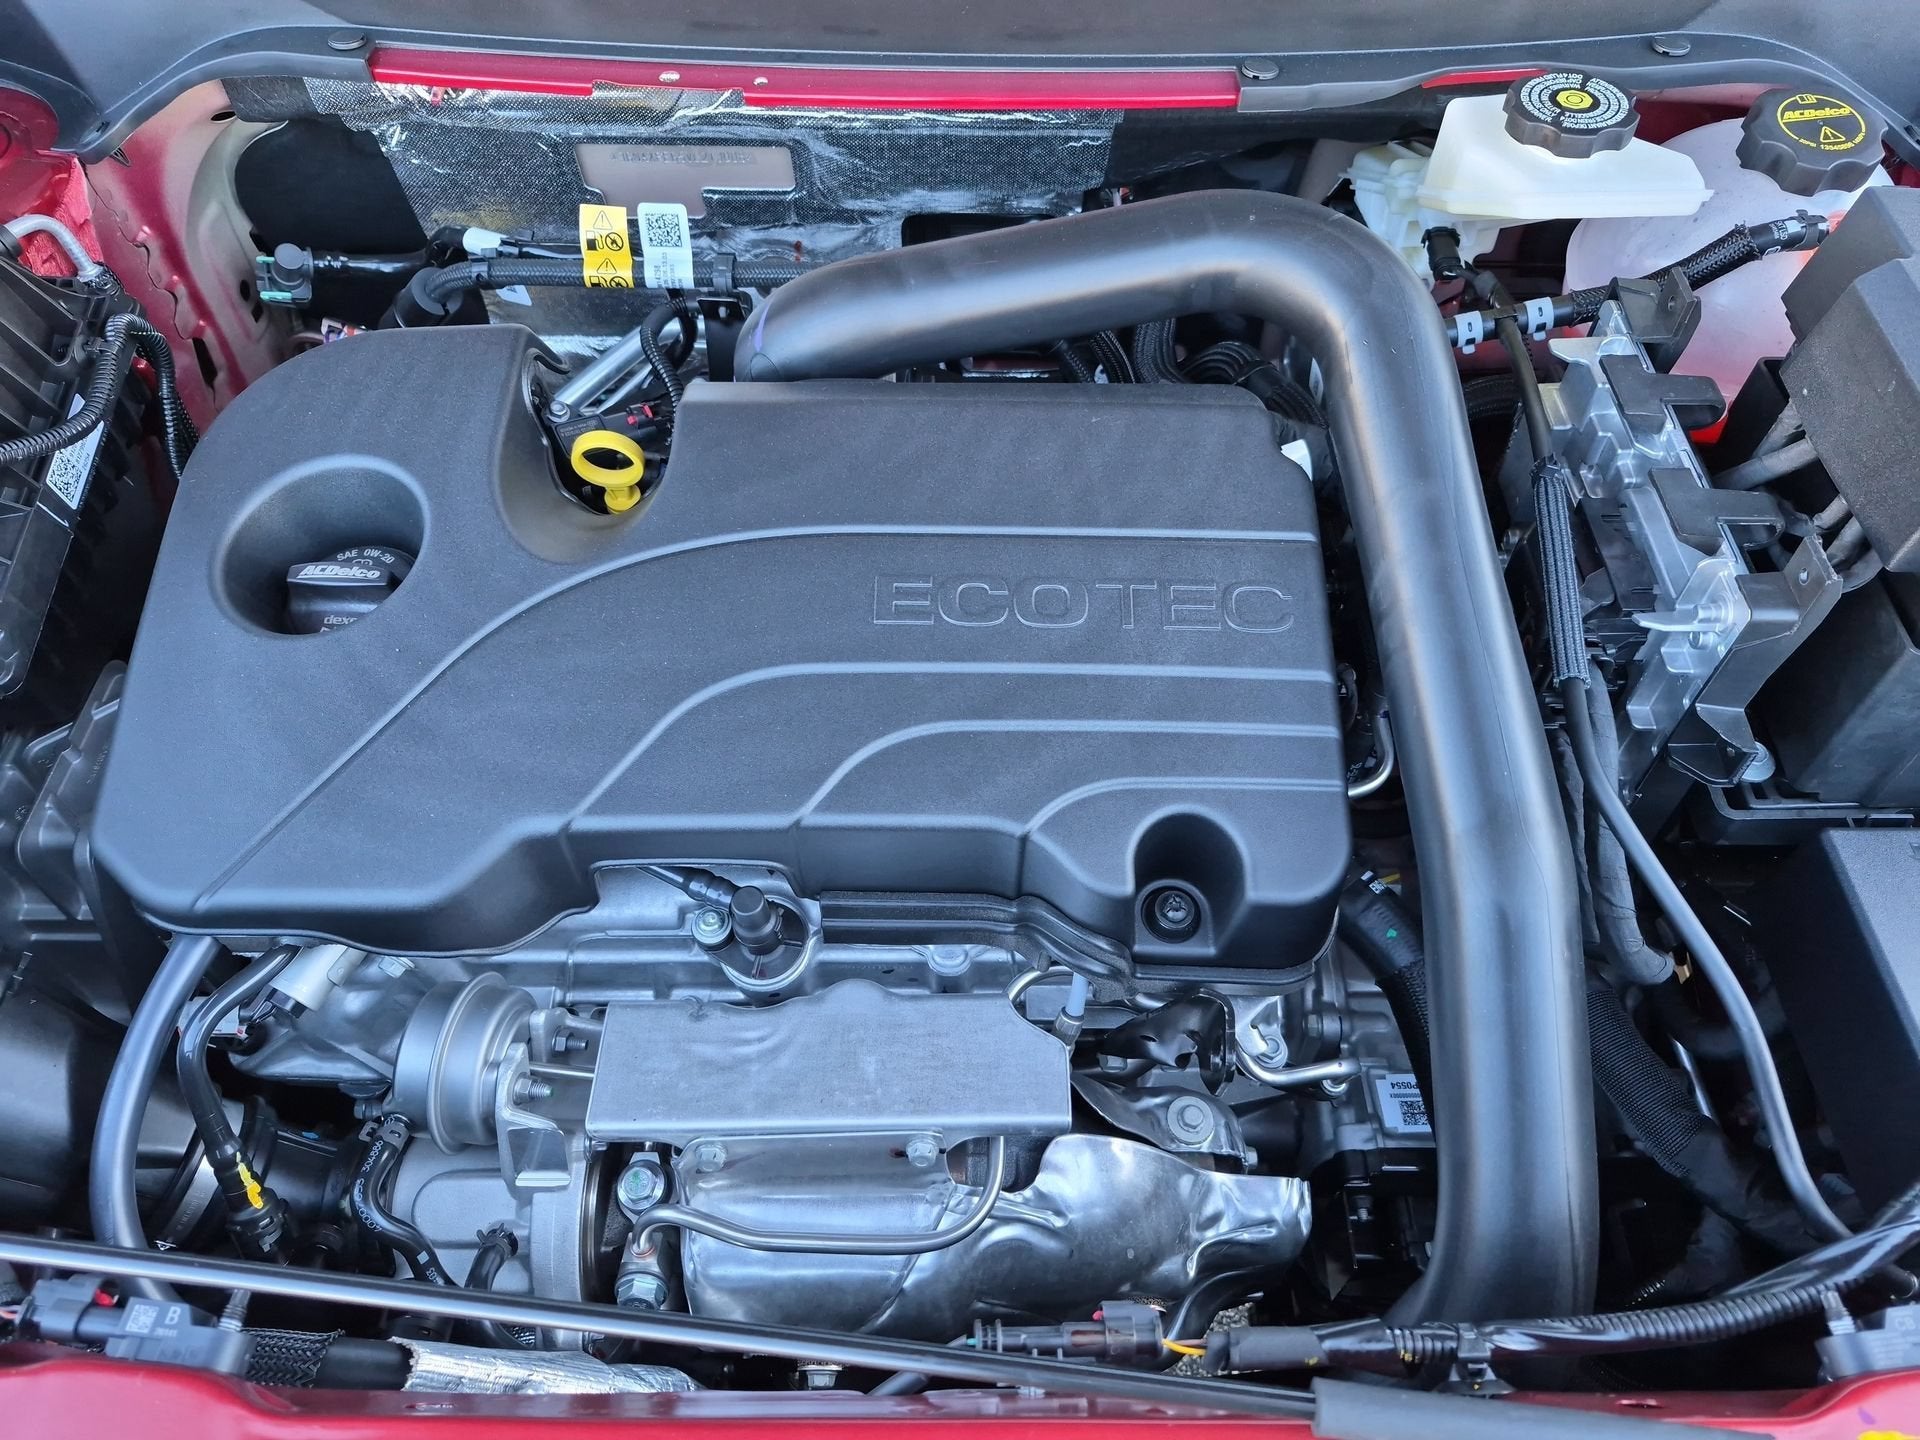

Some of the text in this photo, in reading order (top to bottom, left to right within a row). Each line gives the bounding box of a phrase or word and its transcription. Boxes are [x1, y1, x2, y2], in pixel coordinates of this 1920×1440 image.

[1783, 107, 1851, 120] ACDelco
[337, 548, 395, 564] SAE 0W-20
[297, 565, 381, 579] ACDelco
[873, 575, 1295, 633] ECOTEC
[361, 1140, 383, 1173] 304886
[164, 1306, 182, 1325] B
